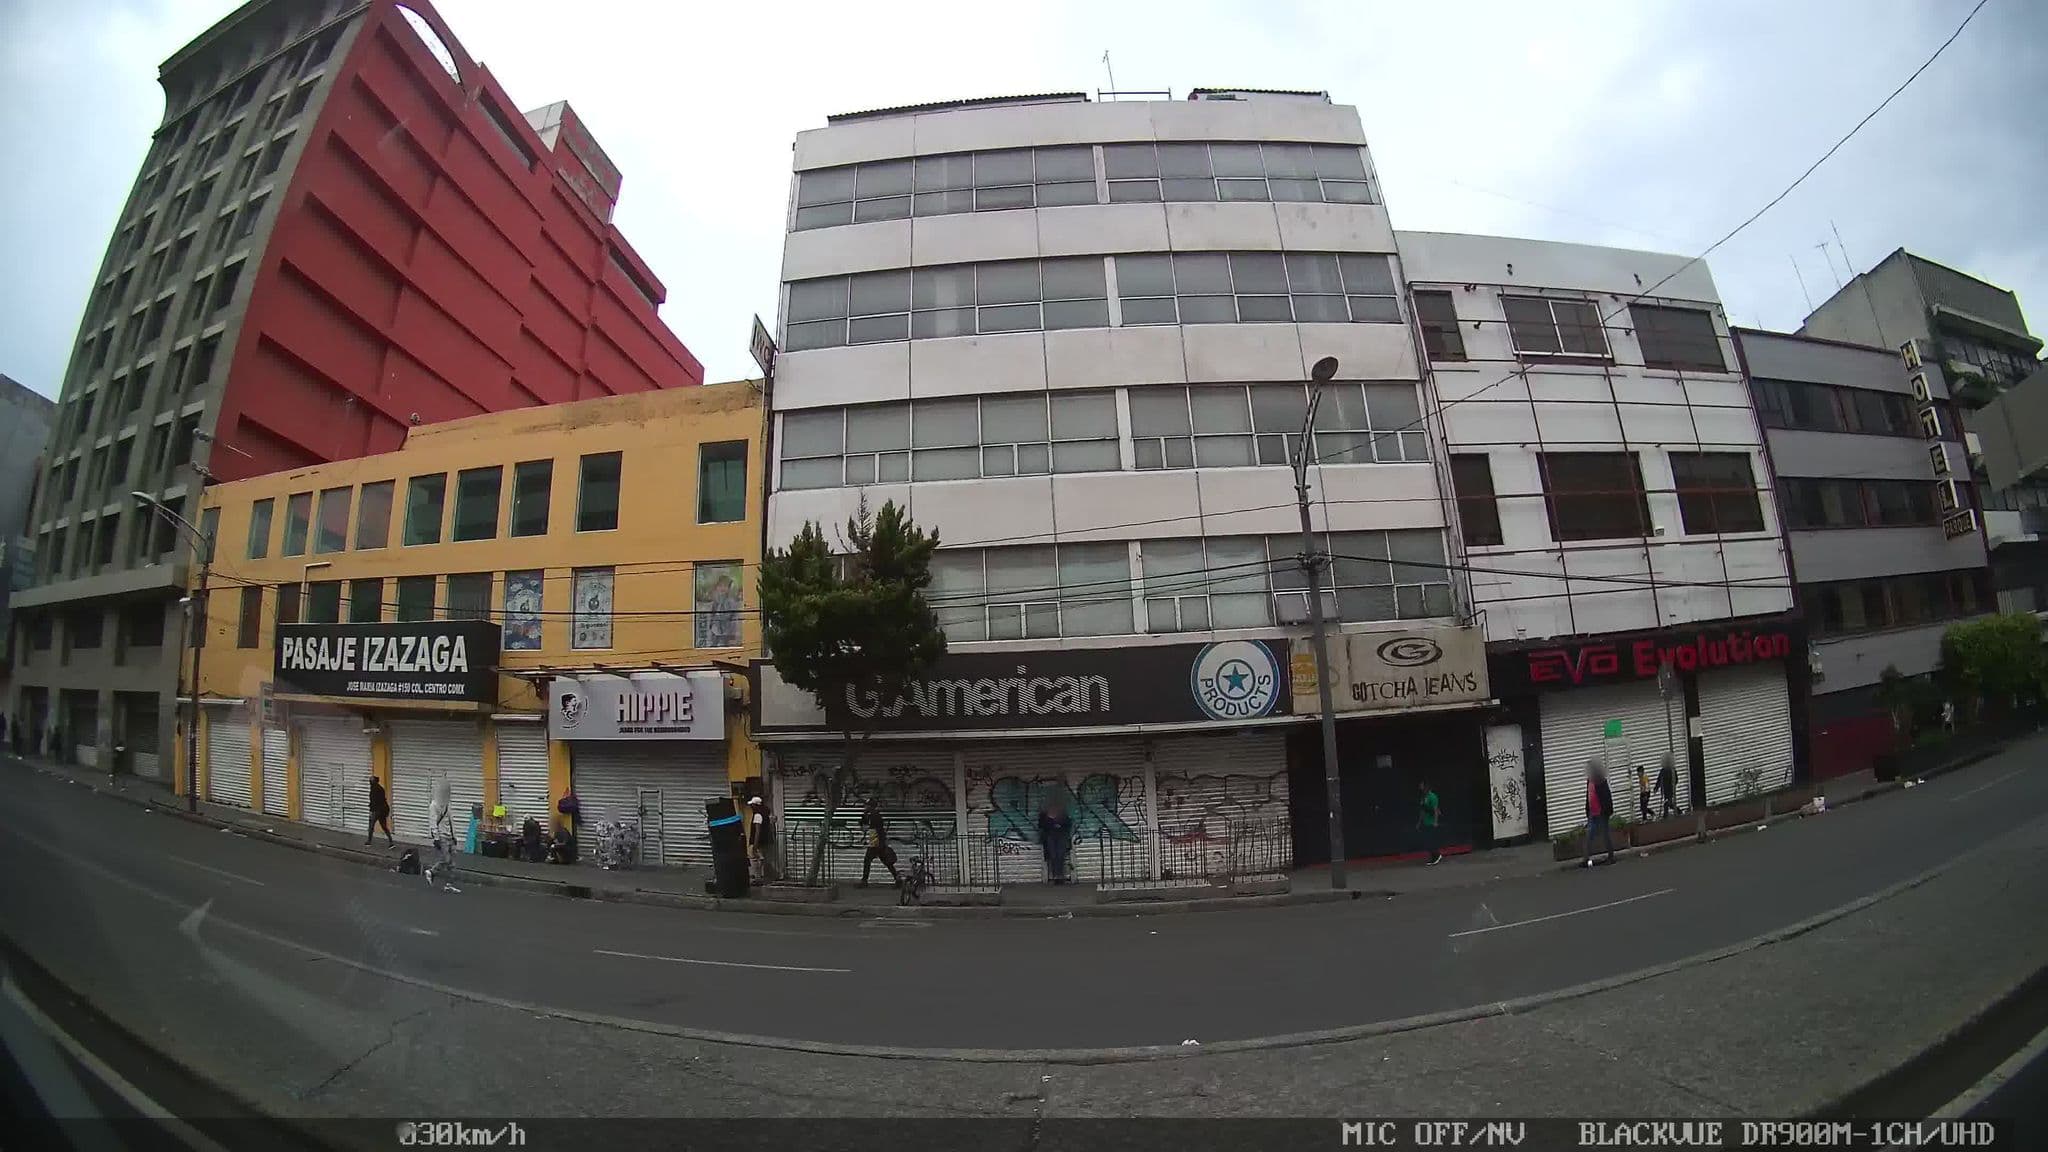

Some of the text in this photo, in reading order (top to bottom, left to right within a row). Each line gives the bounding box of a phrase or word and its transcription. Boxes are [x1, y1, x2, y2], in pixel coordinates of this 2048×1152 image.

[282, 635, 468, 673] PASAJE IZAZAGA
[1632, 631, 1790, 677] Evolution
[375, 682, 397, 693] IZAZAGA
[424, 683, 447, 695] CENTRO
[1201, 674, 1271, 716] PRODUCTS
[1352, 670, 1477, 702] GOTCHA JEANS
[616, 692, 694, 722] HIPPIE
